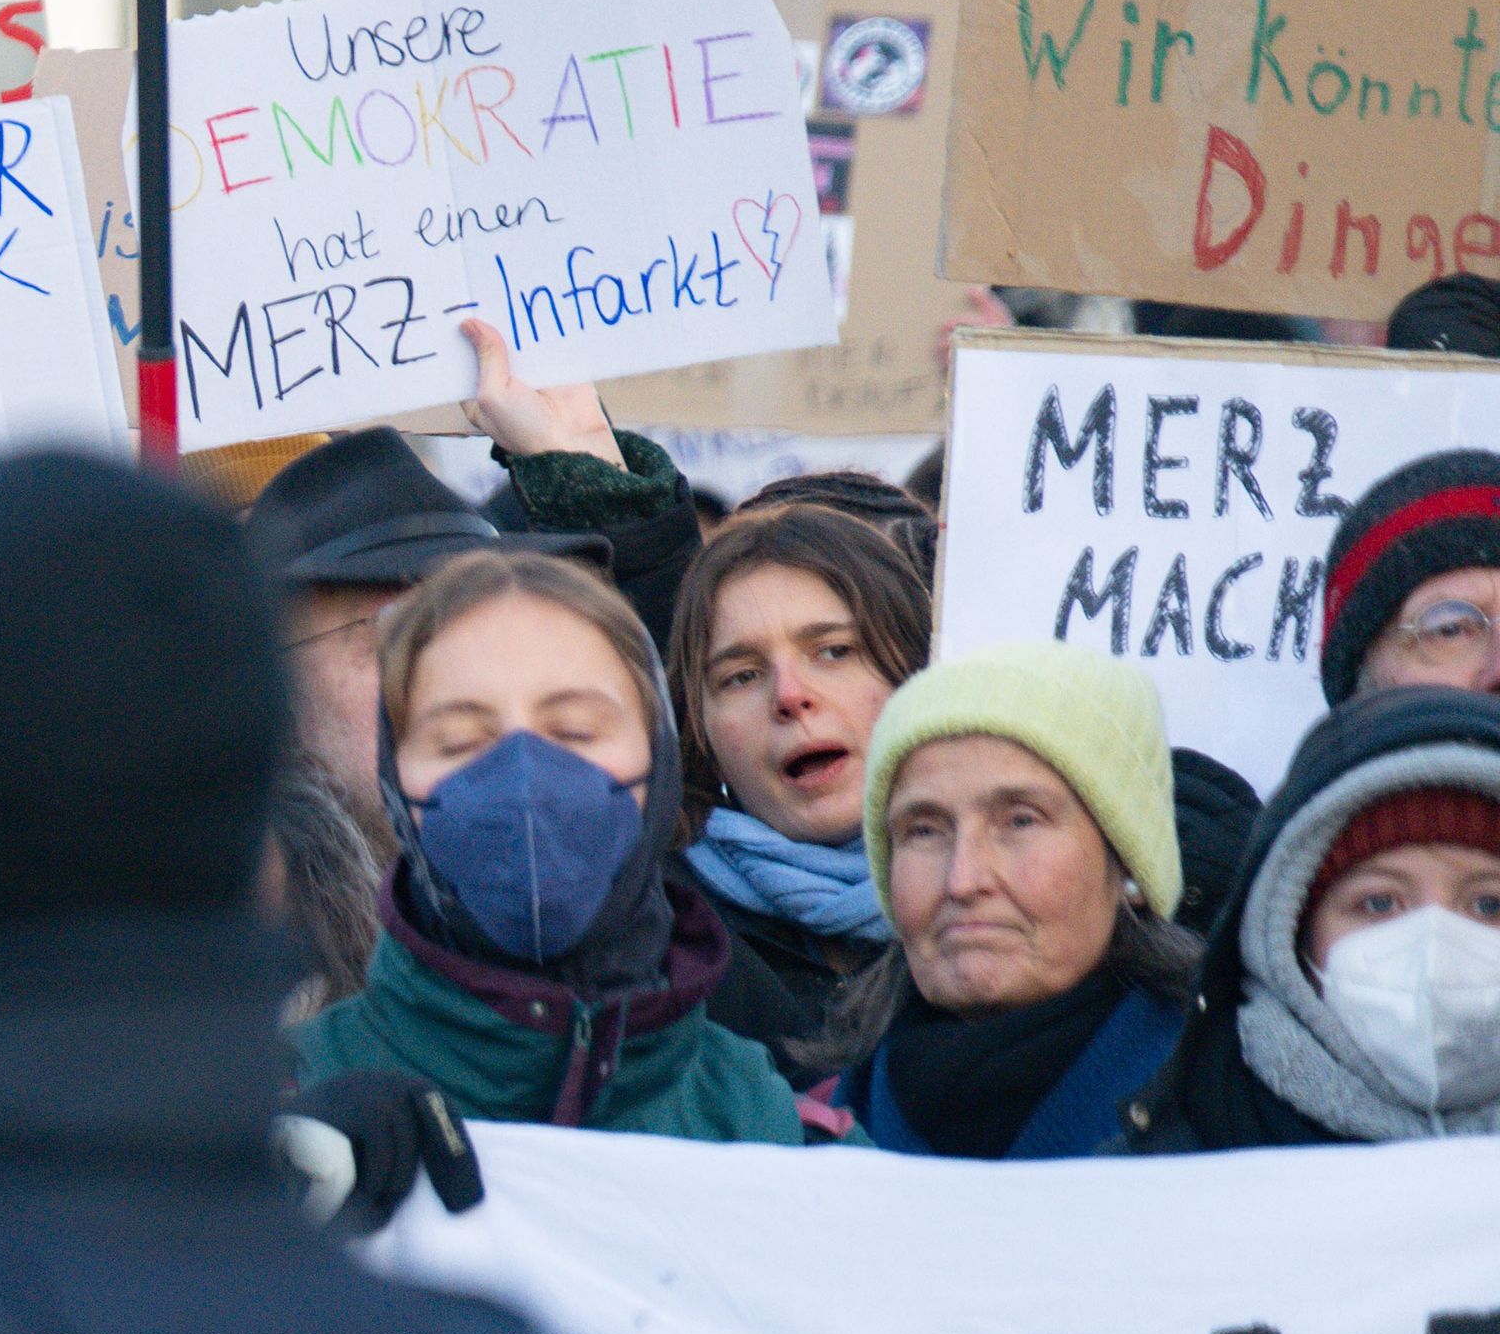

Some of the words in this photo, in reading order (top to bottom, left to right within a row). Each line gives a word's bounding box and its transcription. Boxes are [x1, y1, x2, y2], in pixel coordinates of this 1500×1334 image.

[286, 3, 501, 83] Unsere
[274, 207, 381, 281] hat
[414, 191, 565, 248] einen
[1022, 380, 1354, 522] MERZ
